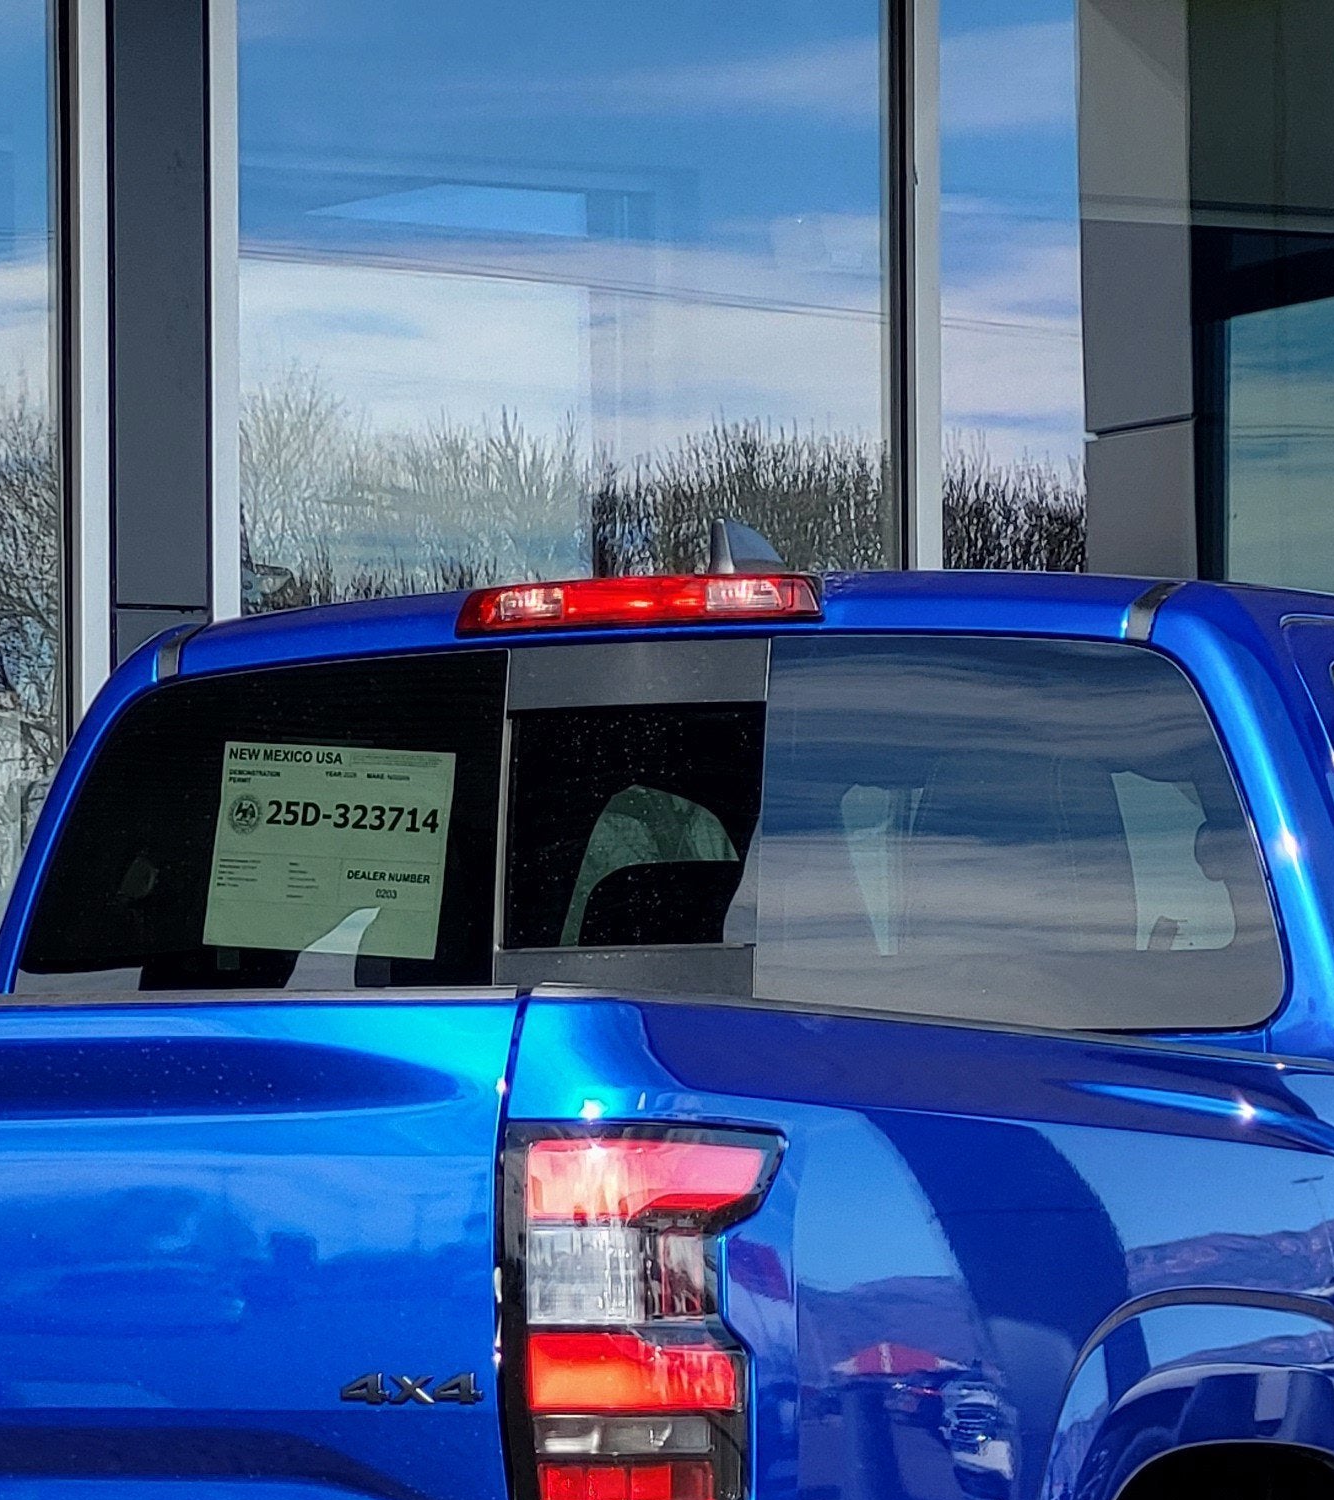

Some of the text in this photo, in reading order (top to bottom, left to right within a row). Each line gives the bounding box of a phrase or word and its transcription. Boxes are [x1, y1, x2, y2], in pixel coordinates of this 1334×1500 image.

[229, 748, 260, 760] NEW
[263, 749, 313, 763] MEXICO
[316, 751, 343, 764] USA
[266, 799, 439, 833] 25D-323714
[347, 869, 430, 884] DEALER NUMBER
